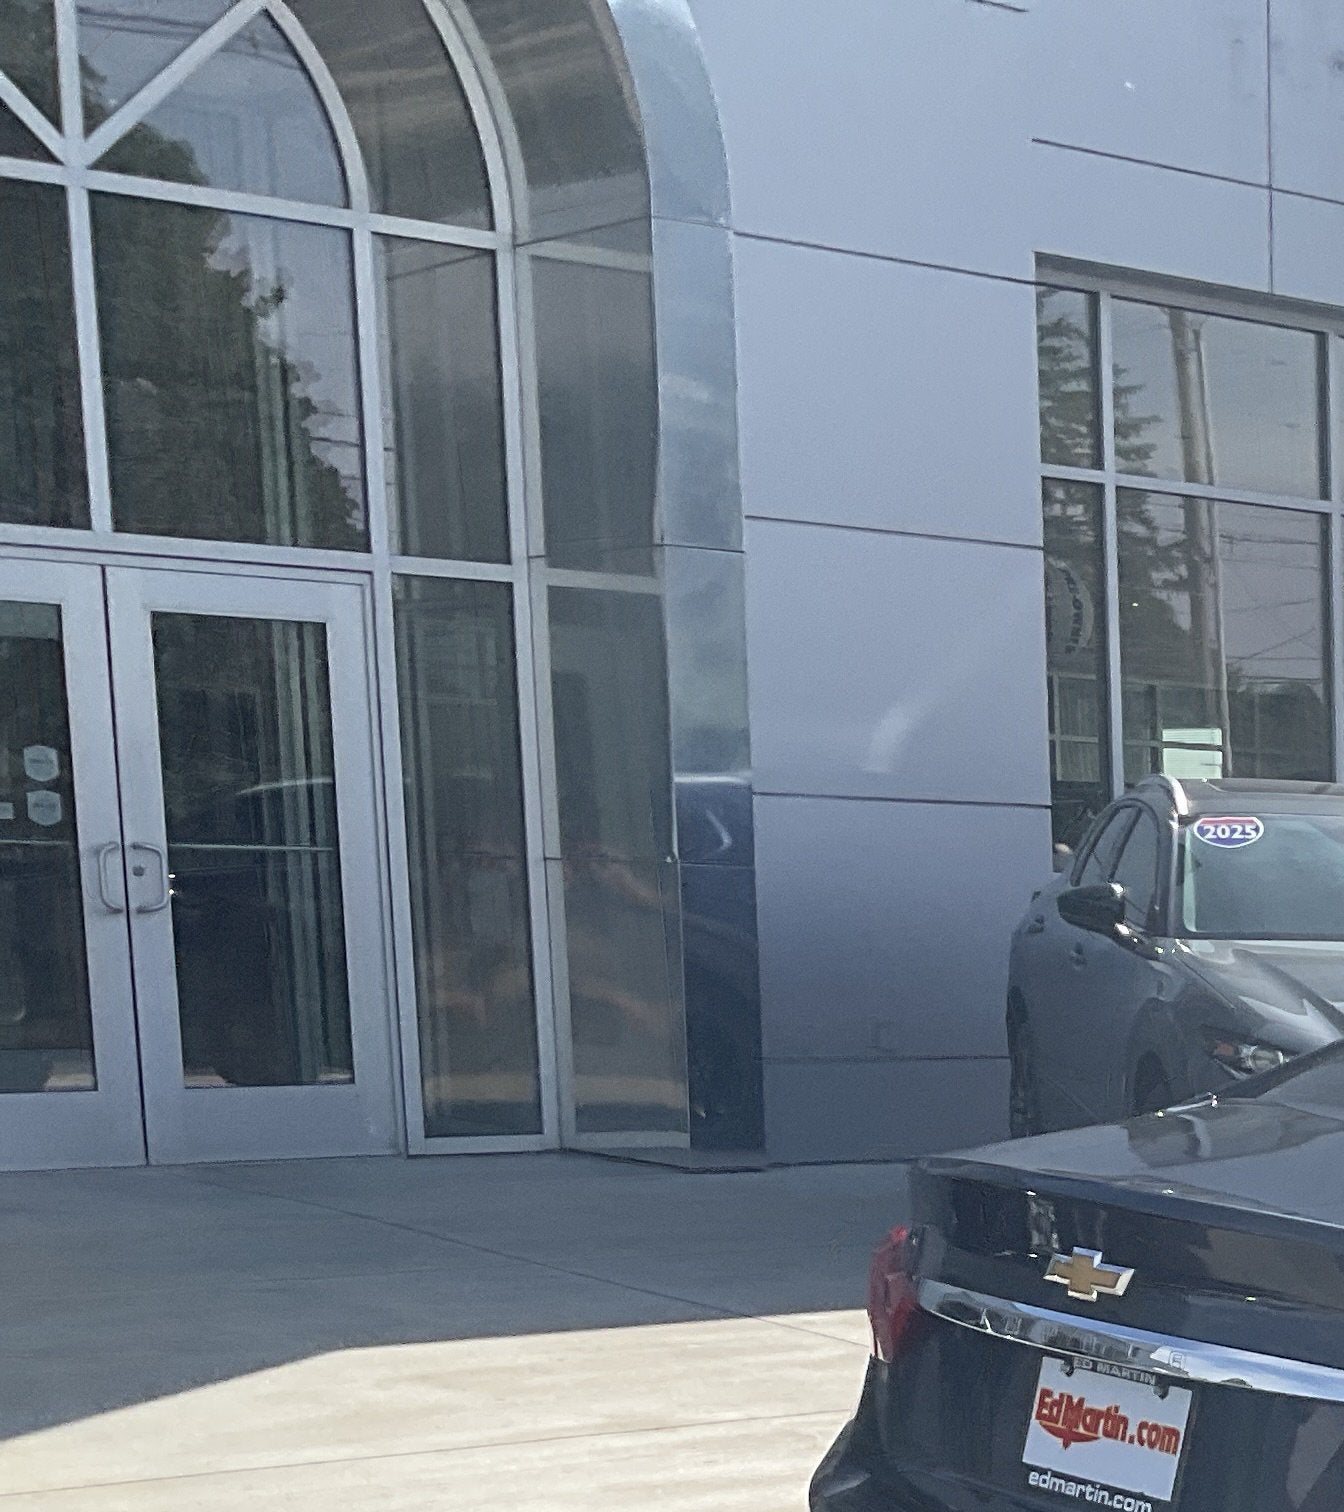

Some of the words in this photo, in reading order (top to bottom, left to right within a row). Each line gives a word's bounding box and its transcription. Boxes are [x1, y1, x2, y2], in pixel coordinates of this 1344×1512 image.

[1203, 824, 1257, 839] 2025
[1096, 1363, 1156, 1386] MARTIN
[1035, 1386, 1181, 1457] EdMartin.com
